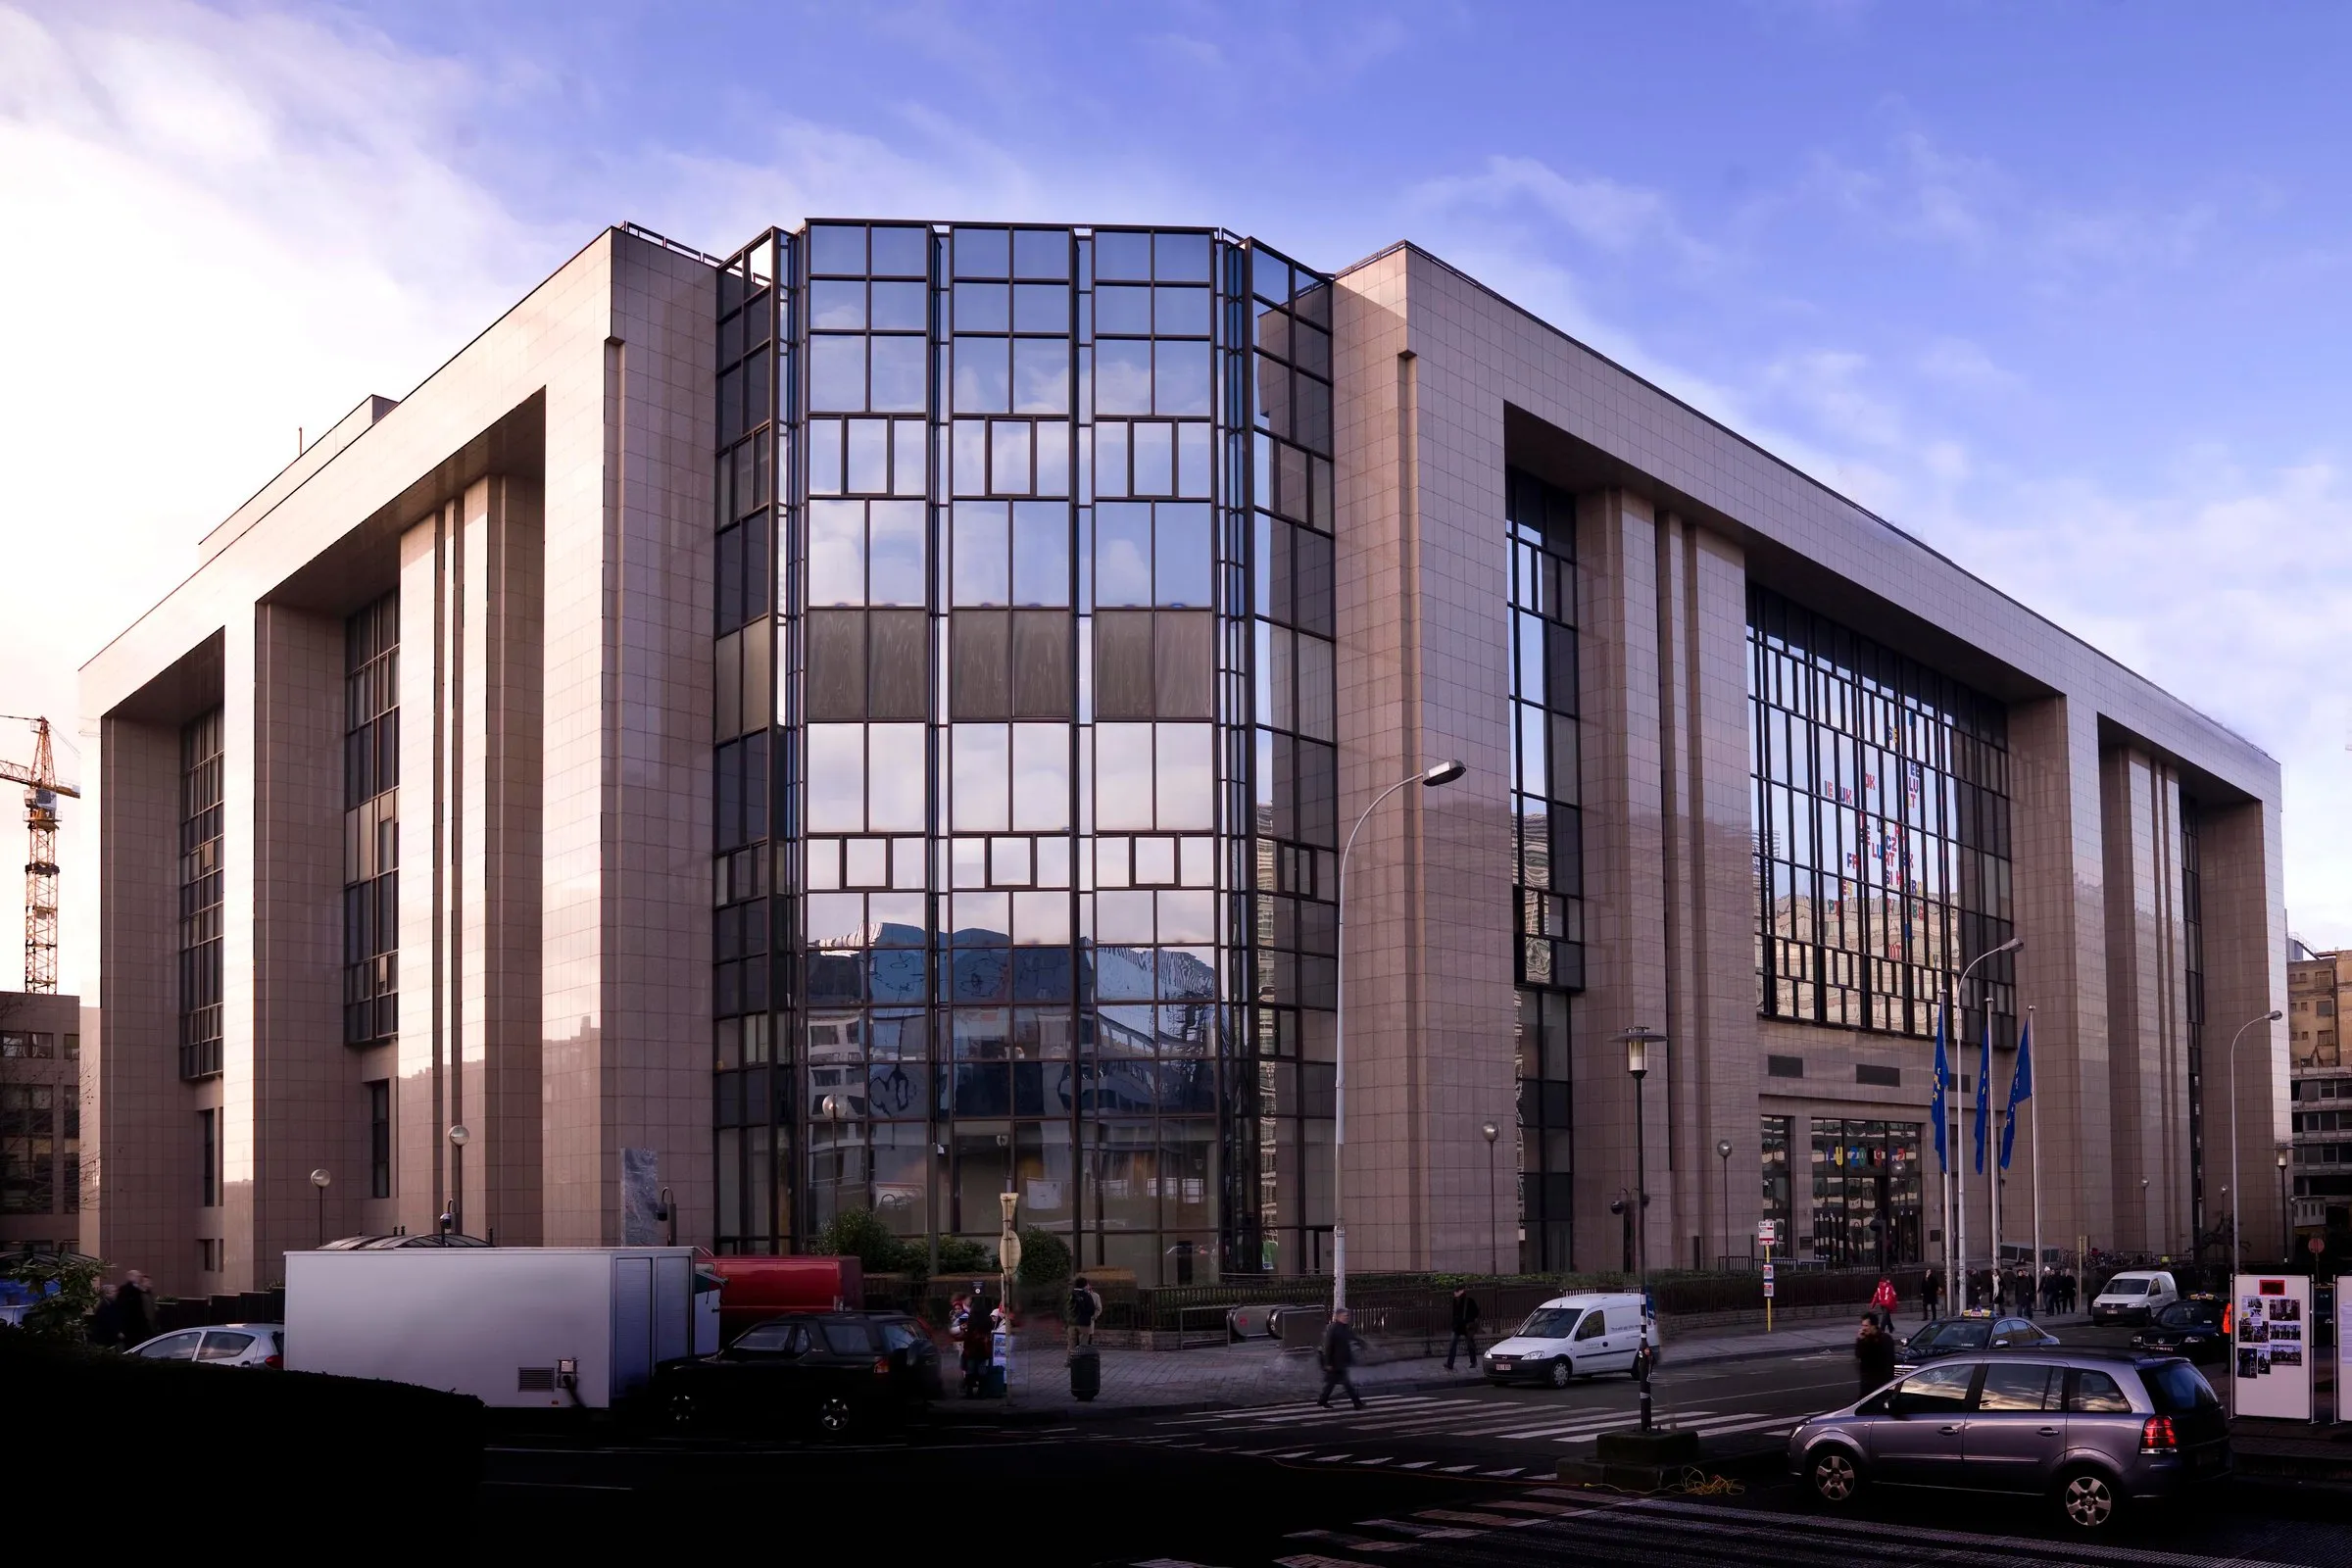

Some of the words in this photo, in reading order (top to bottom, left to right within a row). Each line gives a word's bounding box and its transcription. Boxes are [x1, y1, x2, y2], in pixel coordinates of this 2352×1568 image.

[1825, 780, 1834, 798] IE
[1839, 786, 1852, 805] UK
[1886, 835, 1897, 852] CZ
